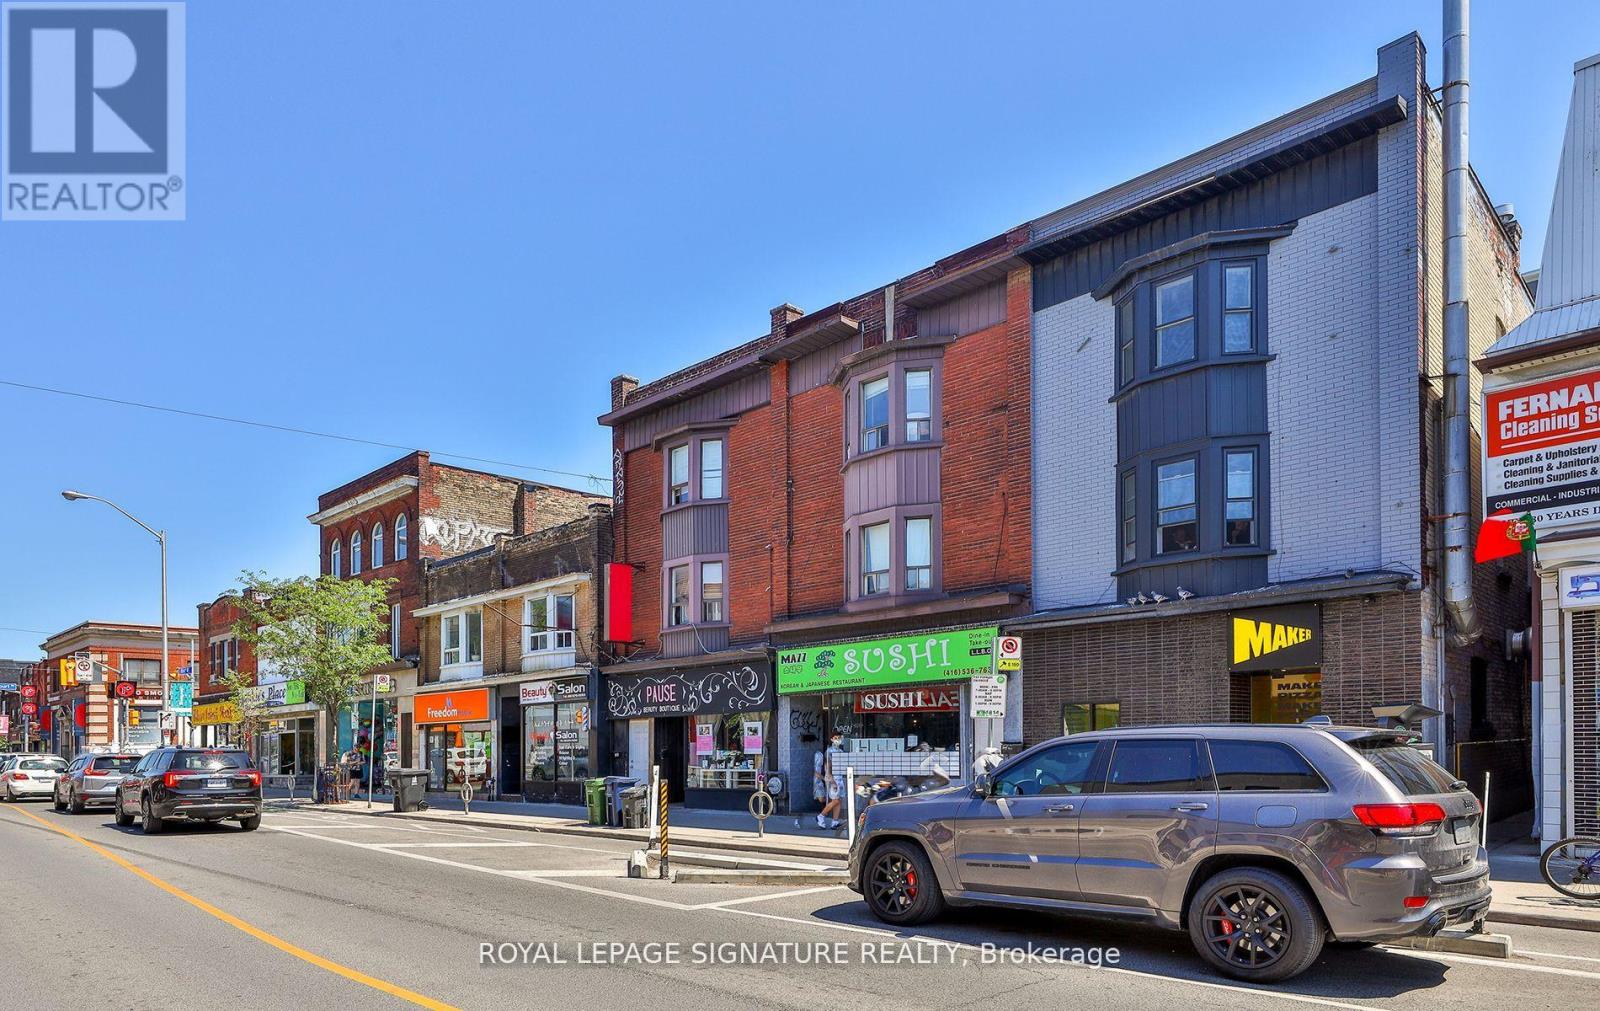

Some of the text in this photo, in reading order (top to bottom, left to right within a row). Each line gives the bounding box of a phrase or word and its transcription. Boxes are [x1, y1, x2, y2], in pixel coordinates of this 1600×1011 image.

[1498, 381, 1600, 421] FERNA
[1501, 405, 1600, 440] Cleaning S
[1503, 444, 1597, 468] Carpet & Upholstery
[1504, 456, 1600, 479] Cleaning & Janitoria
[1504, 466, 1599, 490] Cleaning Supplies &
[1495, 493, 1552, 509] COMMERCIAL
[1547, 508, 1589, 520] YEARS
[1233, 617, 1312, 664] MAKER
[843, 638, 951, 675] SUSHI
[521, 682, 586, 698] Beauty Salon
[832, 678, 865, 686] RESTAURANT
[646, 684, 677, 703] PAUSE
[864, 691, 924, 710] SUSHI
[427, 706, 458, 718] Freedom
